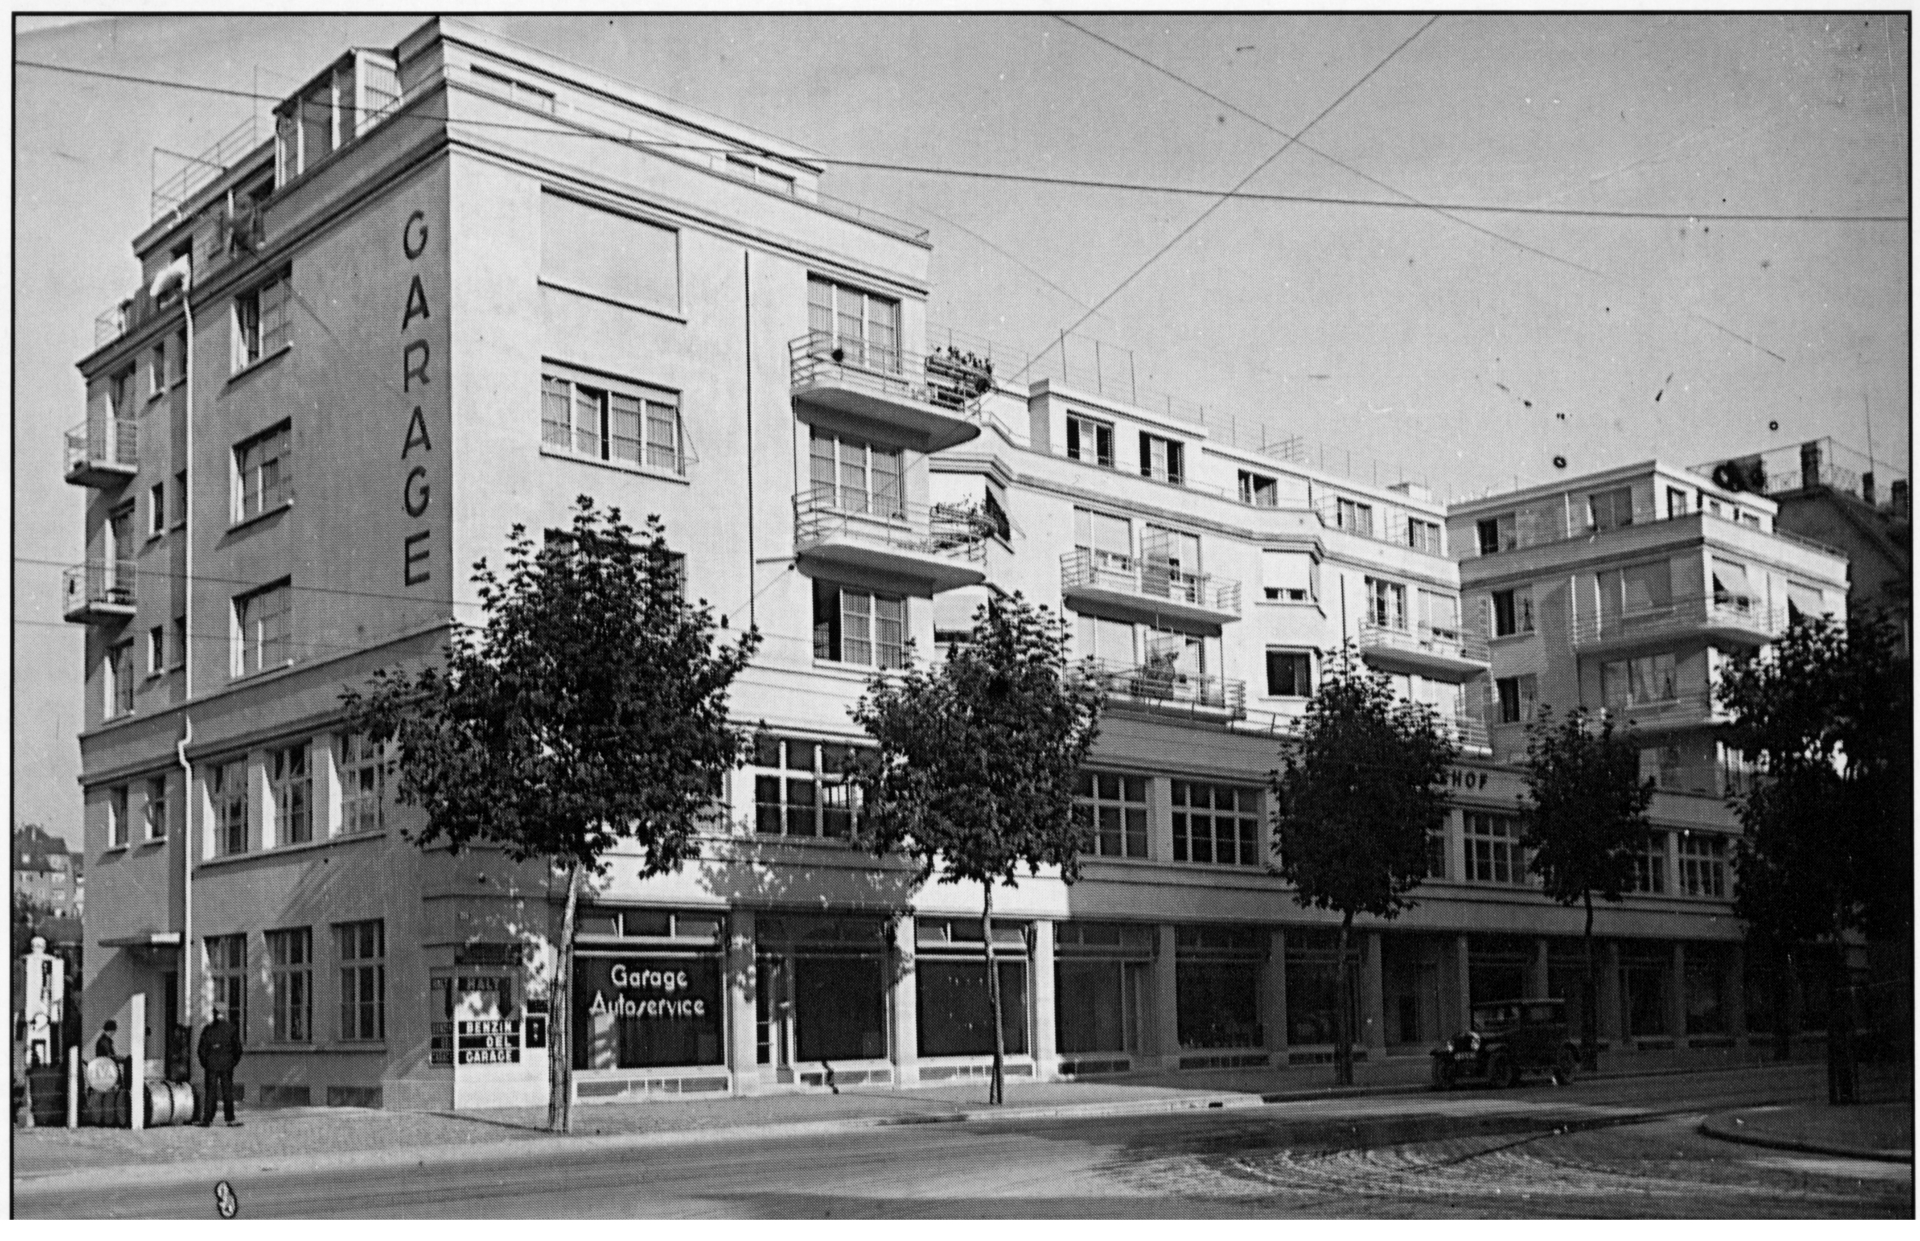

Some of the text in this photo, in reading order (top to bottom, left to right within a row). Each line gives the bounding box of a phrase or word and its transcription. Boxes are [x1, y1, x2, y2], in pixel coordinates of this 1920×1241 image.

[401, 209, 432, 588] GARAGE
[611, 963, 689, 993] Garage
[588, 989, 706, 1017] Autoservice
[465, 1021, 513, 1034] BENZIN
[486, 1036, 512, 1049] OEL
[465, 1050, 513, 1063] GARAGE
